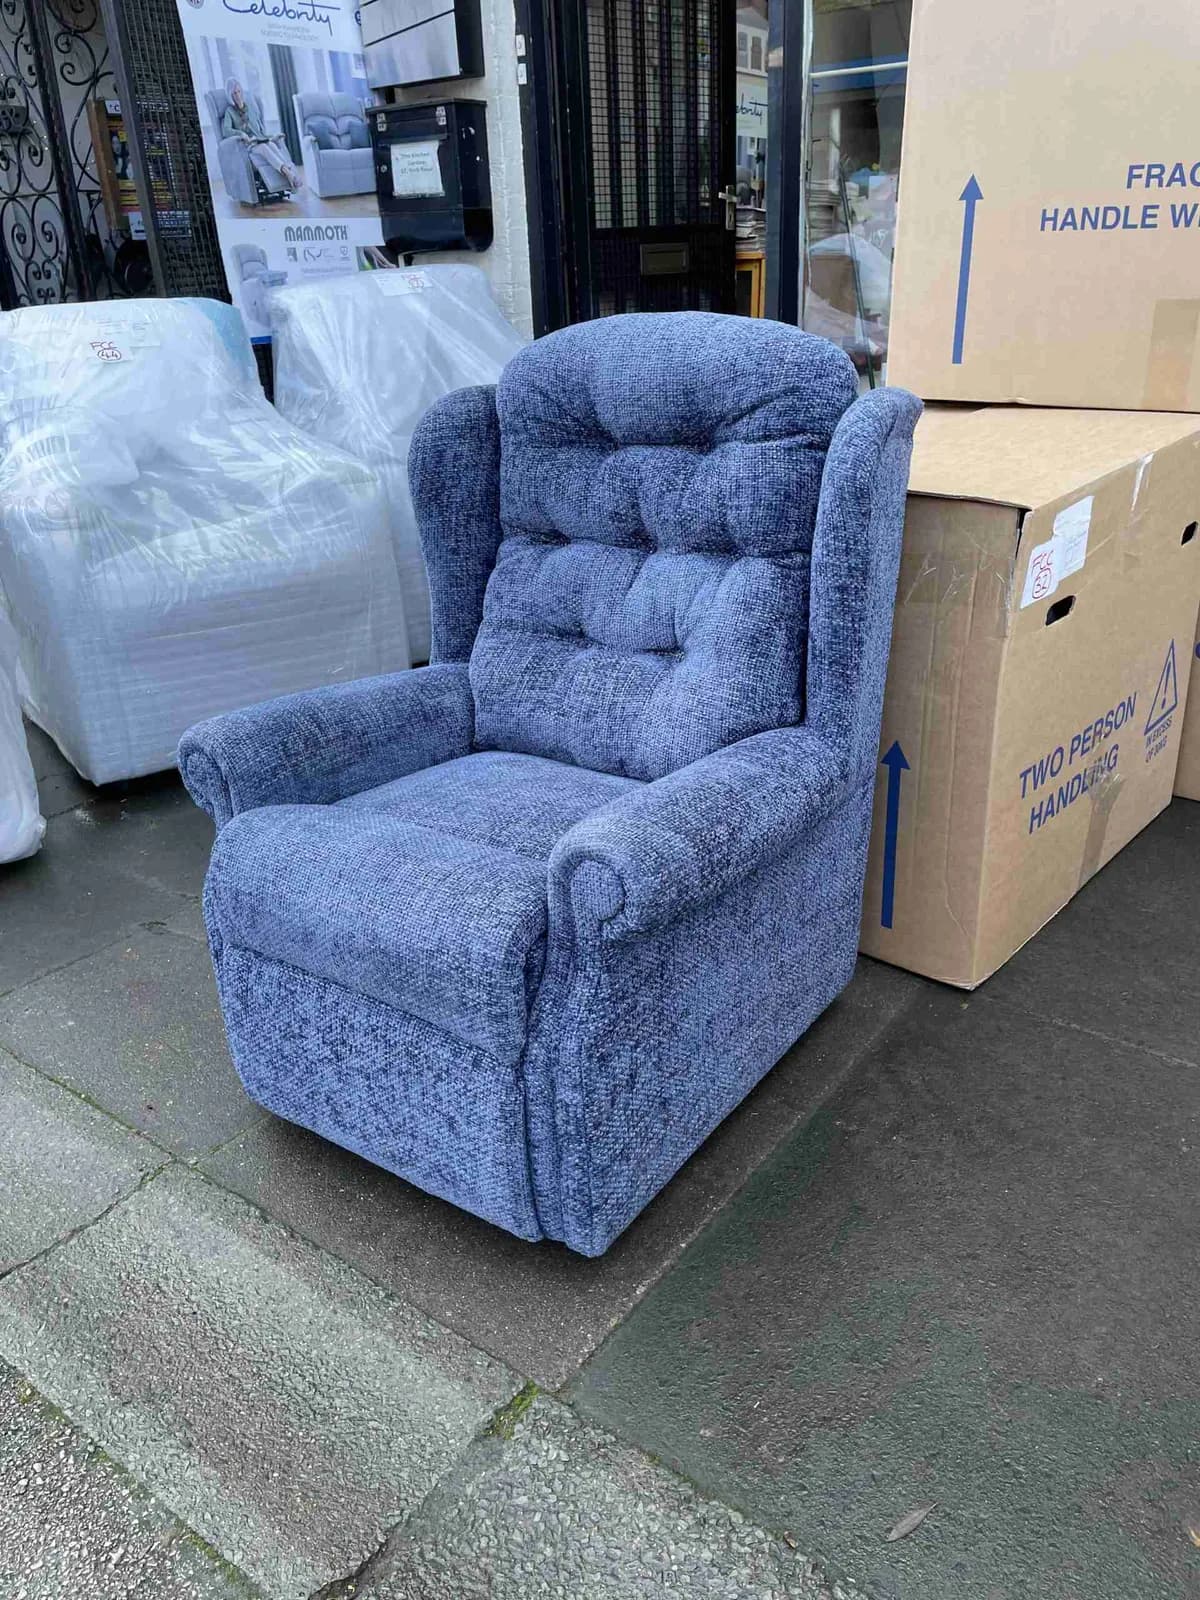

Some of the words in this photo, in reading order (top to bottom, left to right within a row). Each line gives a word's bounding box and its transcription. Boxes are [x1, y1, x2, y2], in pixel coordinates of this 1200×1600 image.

[223, 0, 341, 36] Celebrity
[284, 225, 348, 242] MAMMOTH
[1040, 204, 1160, 232] HANDLE
[1170, 202, 1200, 229] W
[1019, 746, 1064, 799] TWO
[1069, 691, 1137, 765] PERSON
[1029, 743, 1119, 835] HANDLING
